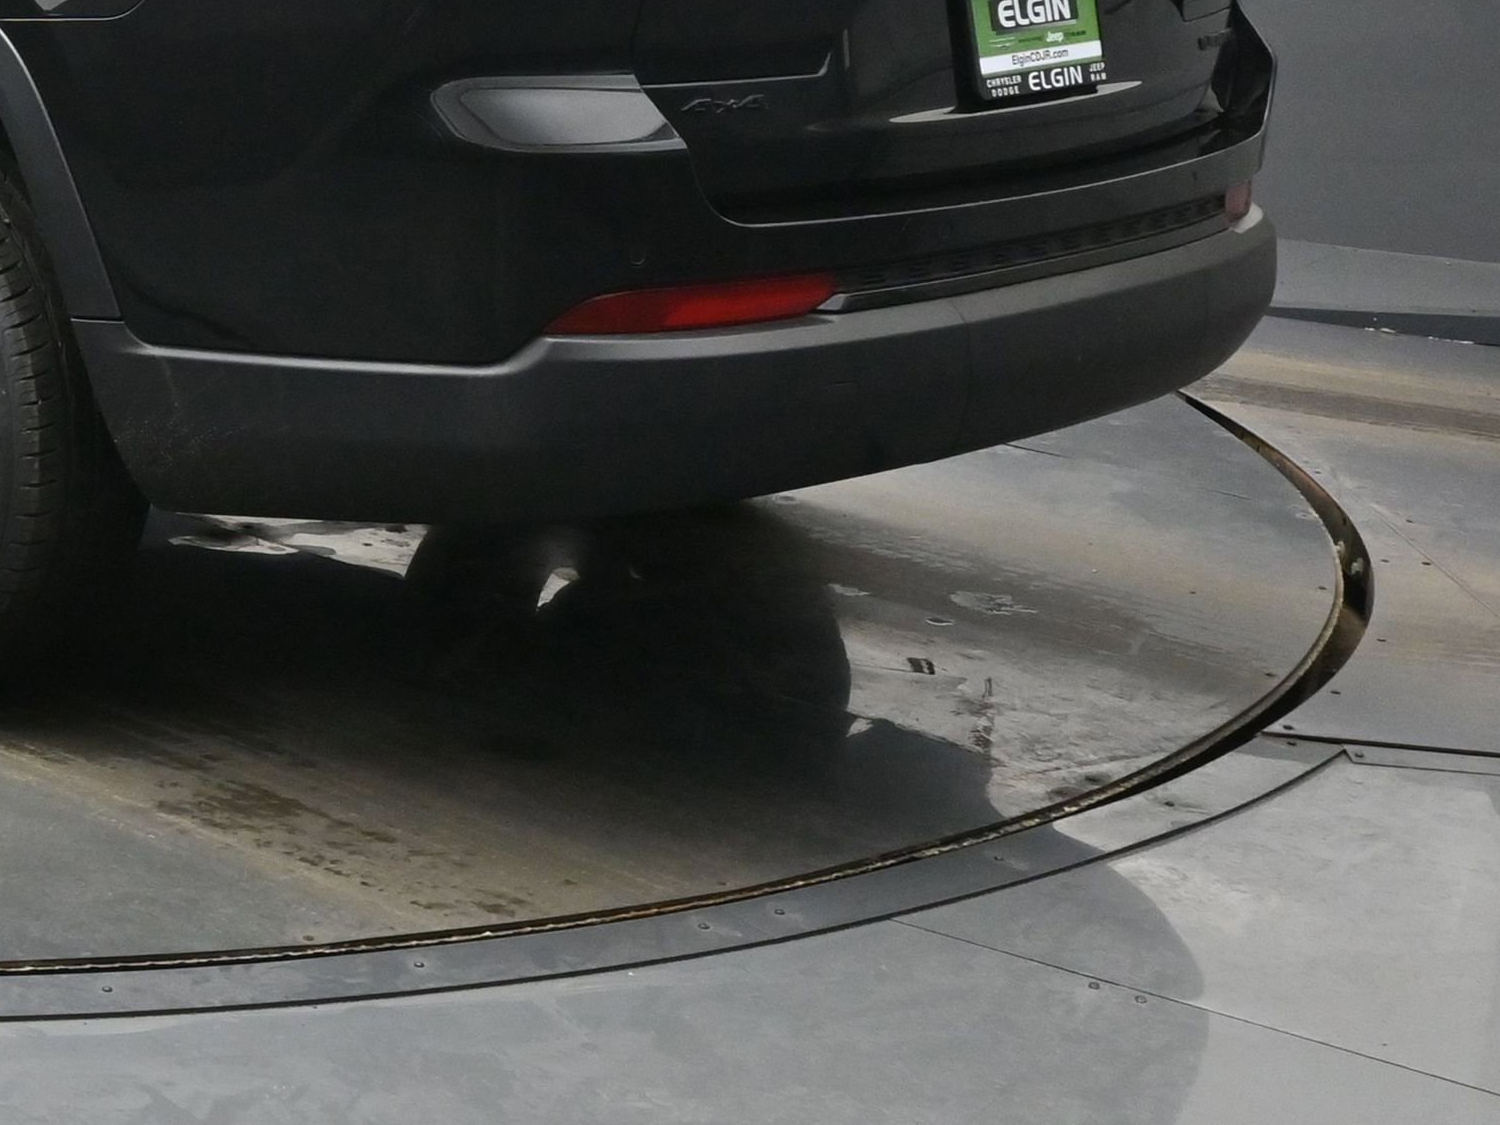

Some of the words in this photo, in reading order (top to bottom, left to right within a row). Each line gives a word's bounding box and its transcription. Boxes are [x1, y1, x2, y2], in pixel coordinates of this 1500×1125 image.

[1011, 49, 1069, 66] ElginCDJR.com
[1089, 62, 1106, 72] JEEP
[986, 75, 1022, 88] CHRYSLER
[1028, 65, 1084, 92] ELGIN
[991, 86, 1020, 98] DODGE
